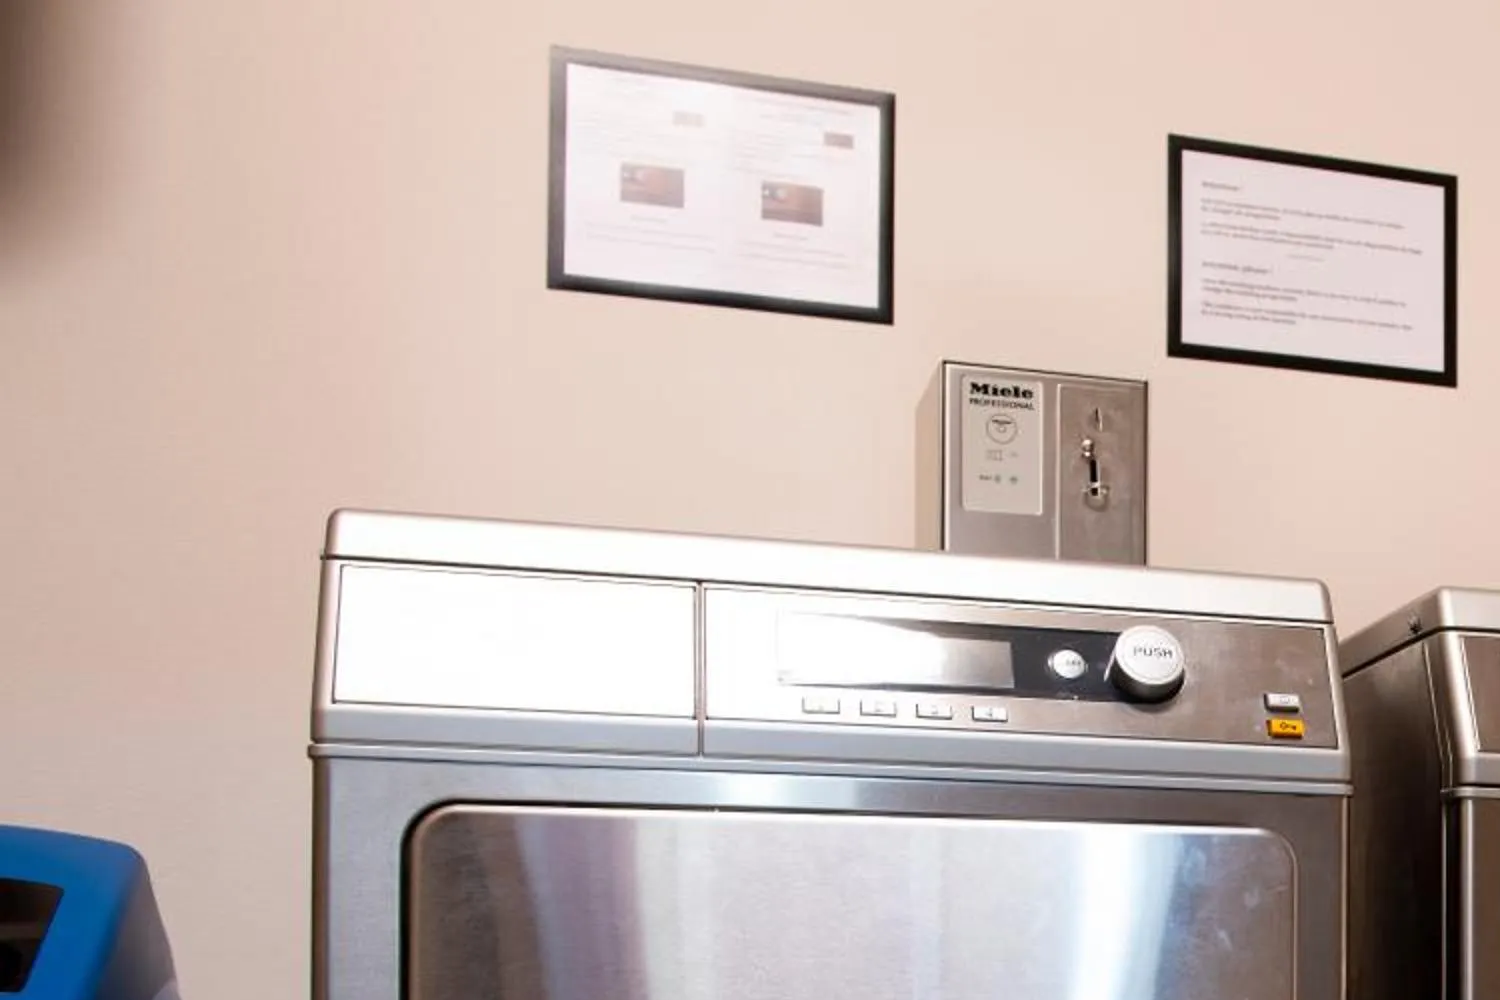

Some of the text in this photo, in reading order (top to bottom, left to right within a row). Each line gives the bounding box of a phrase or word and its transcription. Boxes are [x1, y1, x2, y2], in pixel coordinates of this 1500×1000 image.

[970, 382, 1033, 399] Miele
[969, 398, 1034, 411] PROFESSIONAL
[1132, 646, 1173, 659] PUSH
